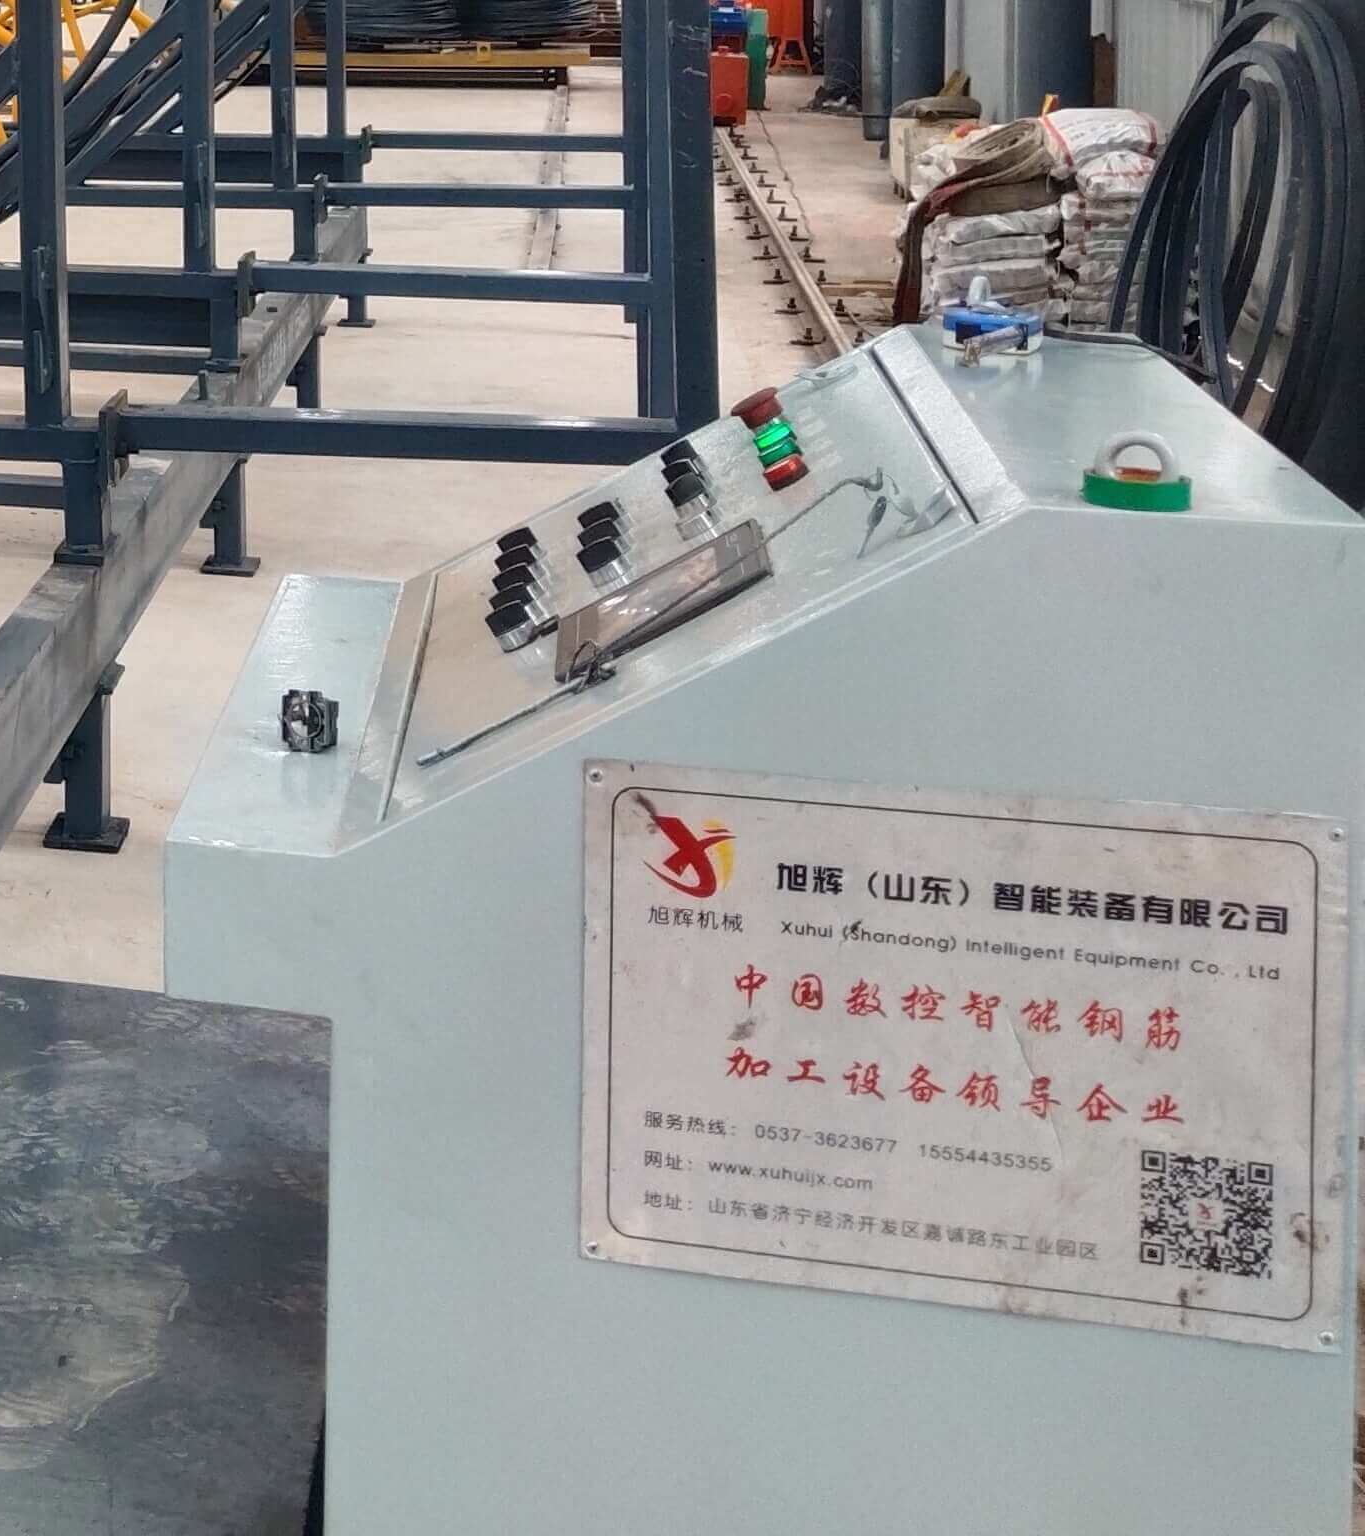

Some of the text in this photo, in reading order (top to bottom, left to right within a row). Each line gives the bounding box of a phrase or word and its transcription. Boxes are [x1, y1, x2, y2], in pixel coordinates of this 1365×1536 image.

[647, 906, 744, 934] 旭辉机械
[776, 862, 1289, 935] 旭辉（山东）智能装备有限公司
[780, 921, 833, 938] Xuhui
[842, 925, 957, 953] (Shandong)
[966, 938, 1065, 962] Intelligent
[1073, 948, 1180, 972] Equipment
[1248, 964, 1280, 980] Ltd
[733, 963, 1184, 1051] 中国数控智能钢筋
[726, 1045, 1185, 1126] 加工设备领导企业
[708, 1161, 873, 1192] www.xuhuijx.com
[754, 1123, 898, 1153] 0537-3623677
[918, 1143, 1054, 1173] 15554435355
